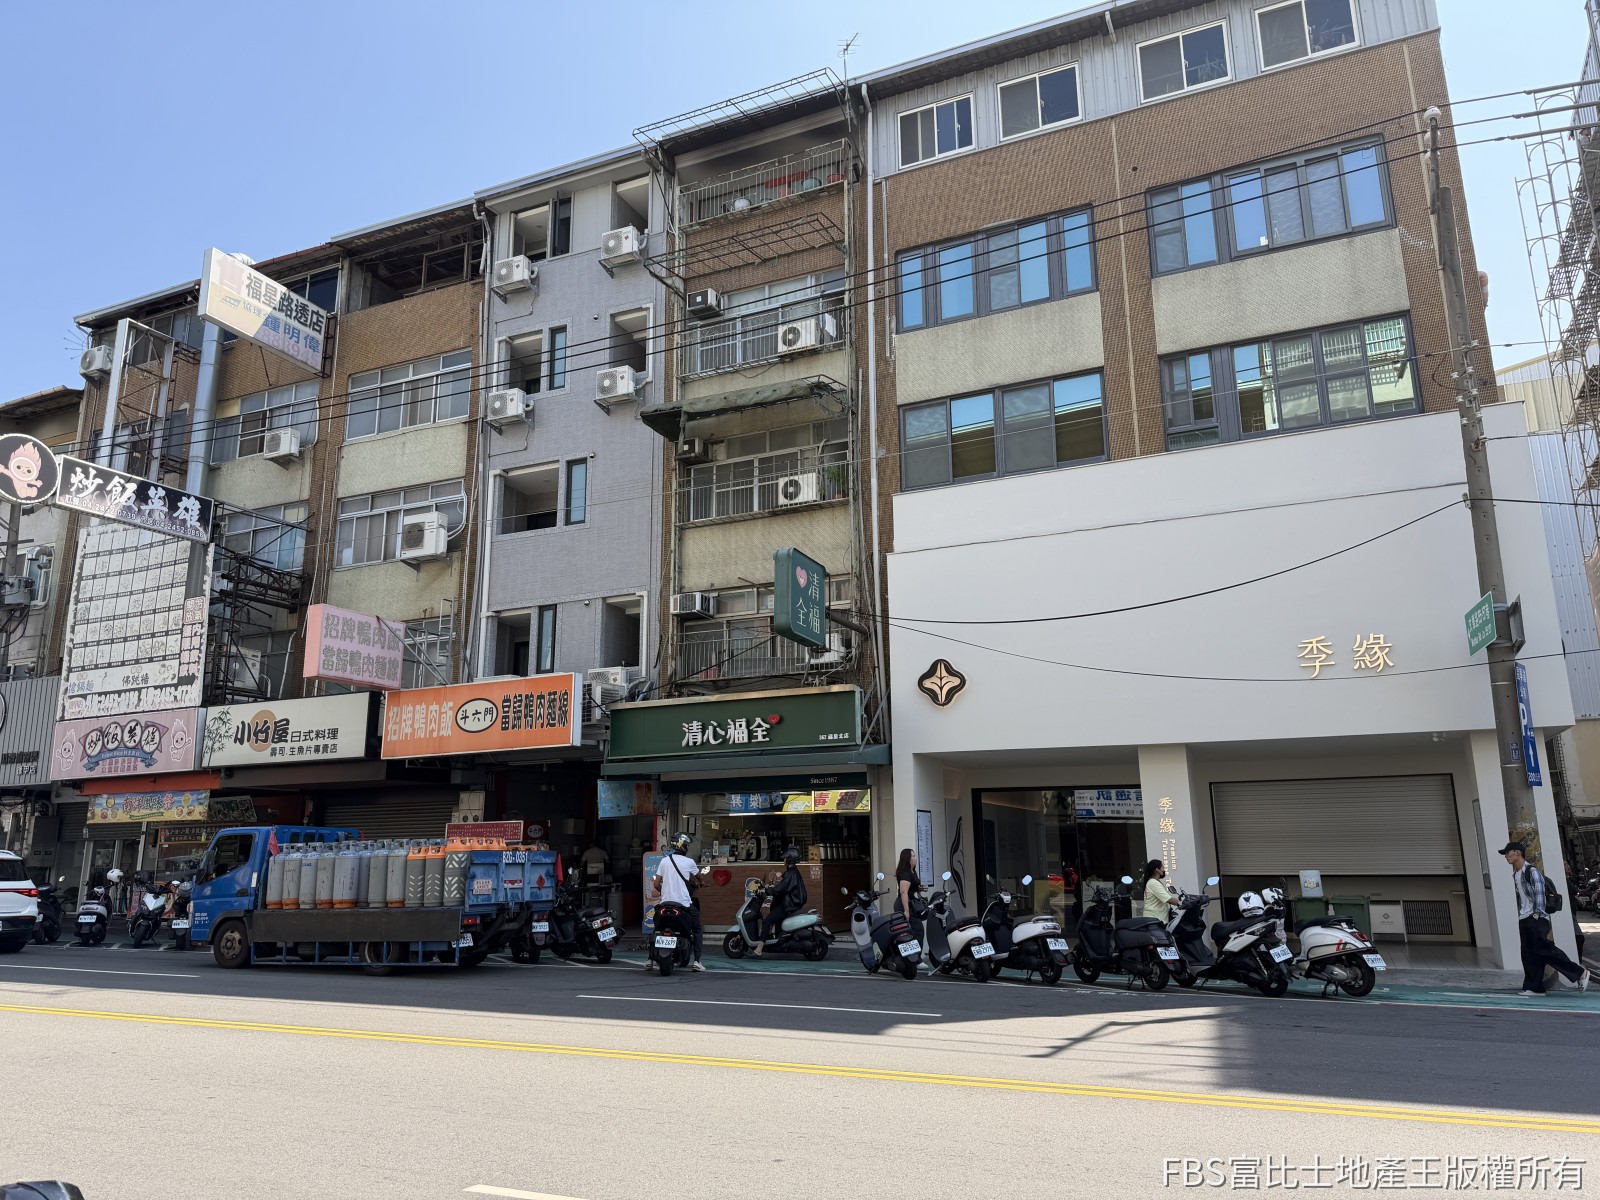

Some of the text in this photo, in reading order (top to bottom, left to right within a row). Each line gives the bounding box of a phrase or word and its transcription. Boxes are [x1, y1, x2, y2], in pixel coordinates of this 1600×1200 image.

[70, 466, 202, 528] 炒飯英雄
[1296, 633, 1395, 679] 季緣
[233, 717, 340, 746] 小竹屋 日式料理
[387, 688, 570, 742] 招牌鴨肉飯 斗六門 當歸鴨肉麵線
[681, 716, 771, 748] 清心福全
[1158, 796, 1176, 835] 季緣
[1169, 838, 1177, 870] Premium
